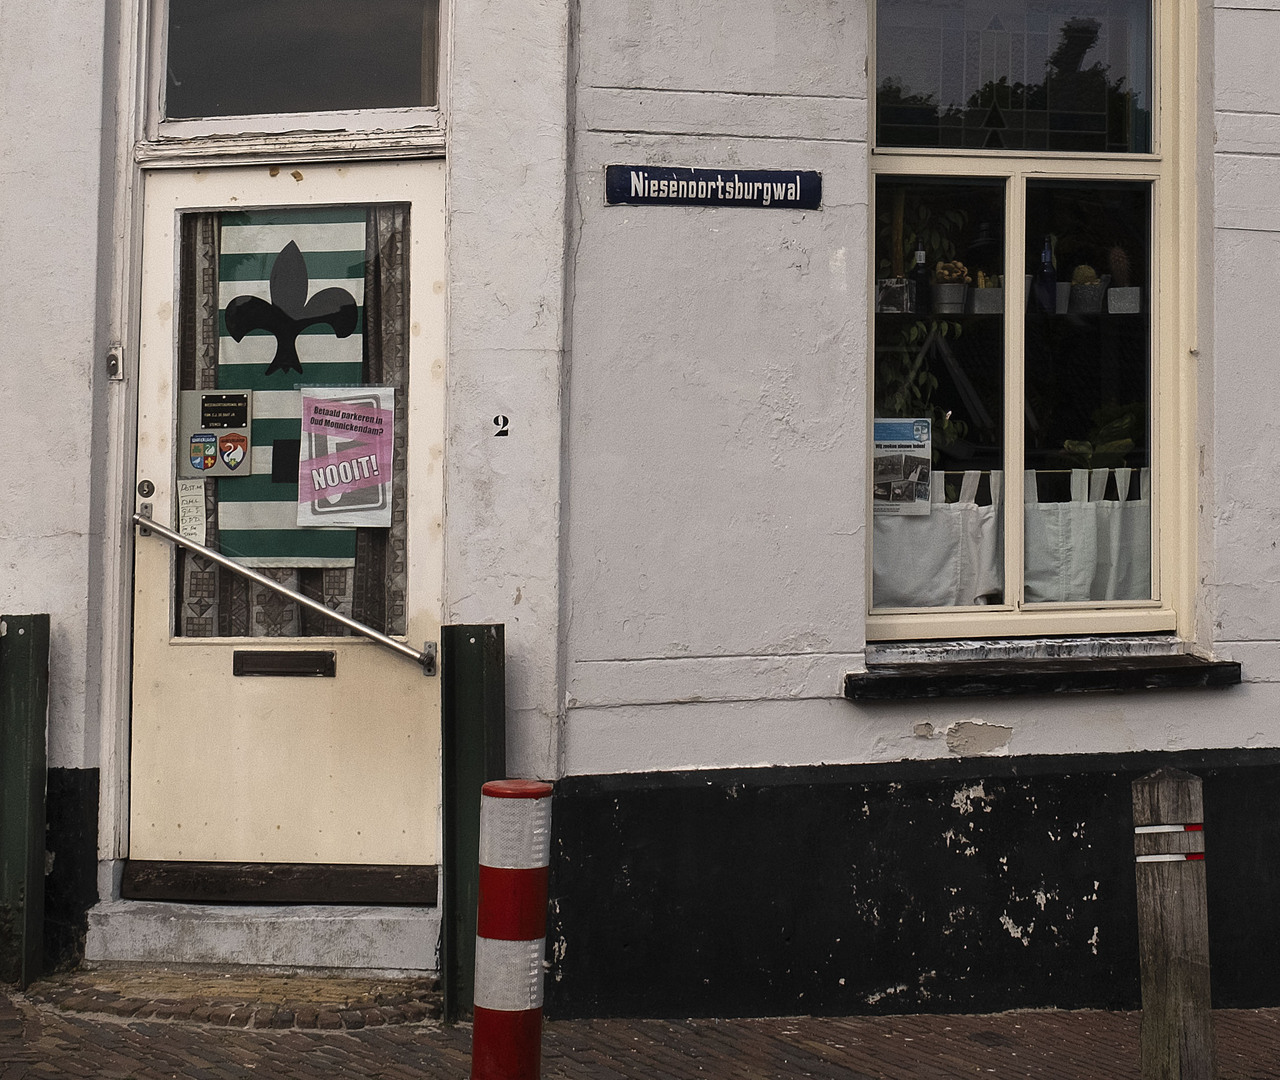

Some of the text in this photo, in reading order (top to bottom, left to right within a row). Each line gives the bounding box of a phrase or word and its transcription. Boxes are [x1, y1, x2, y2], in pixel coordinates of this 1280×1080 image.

[630, 171, 801, 206] Niesenoortsburgwal
[310, 416, 384, 436] Oud Monnickendam?
[313, 406, 383, 425] Betaald parkeren in
[493, 414, 509, 437] 2
[311, 453, 380, 492] NOOIT!
